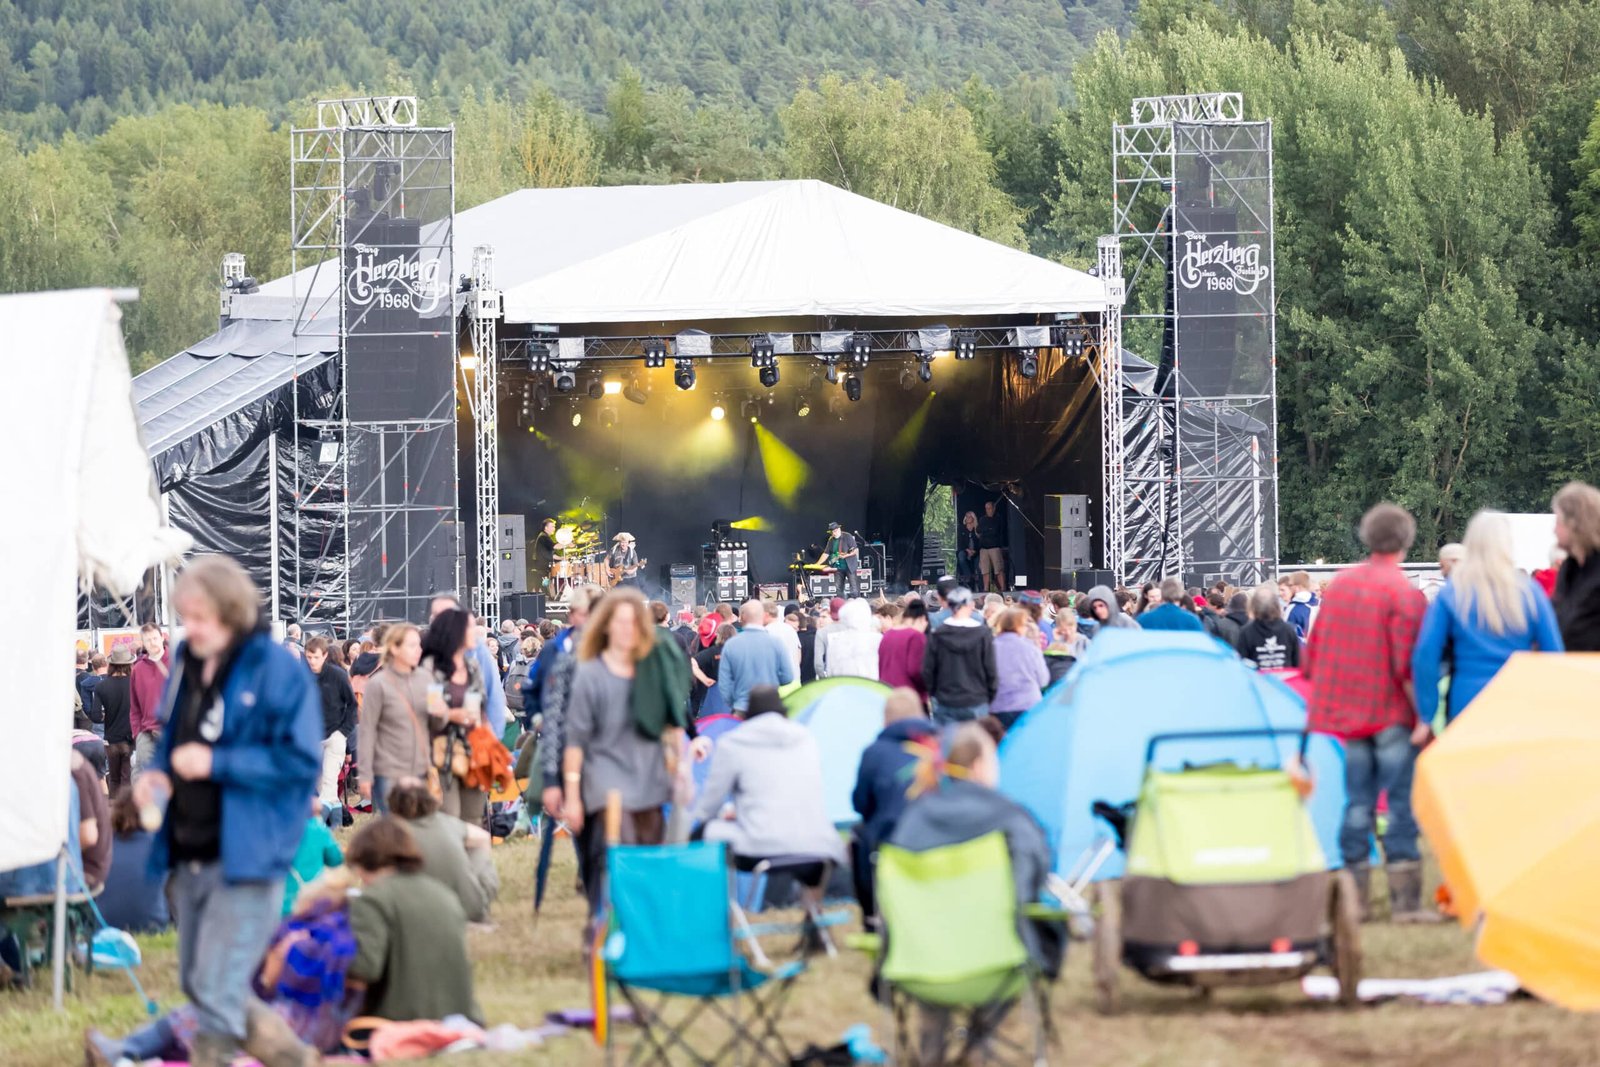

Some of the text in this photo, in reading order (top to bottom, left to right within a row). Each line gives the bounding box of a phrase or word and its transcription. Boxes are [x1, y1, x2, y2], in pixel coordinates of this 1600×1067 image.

[1184, 230, 1207, 243] Burg
[353, 243, 380, 257] Burg
[1206, 277, 1233, 291] 1968
[380, 293, 410, 308] 1968
